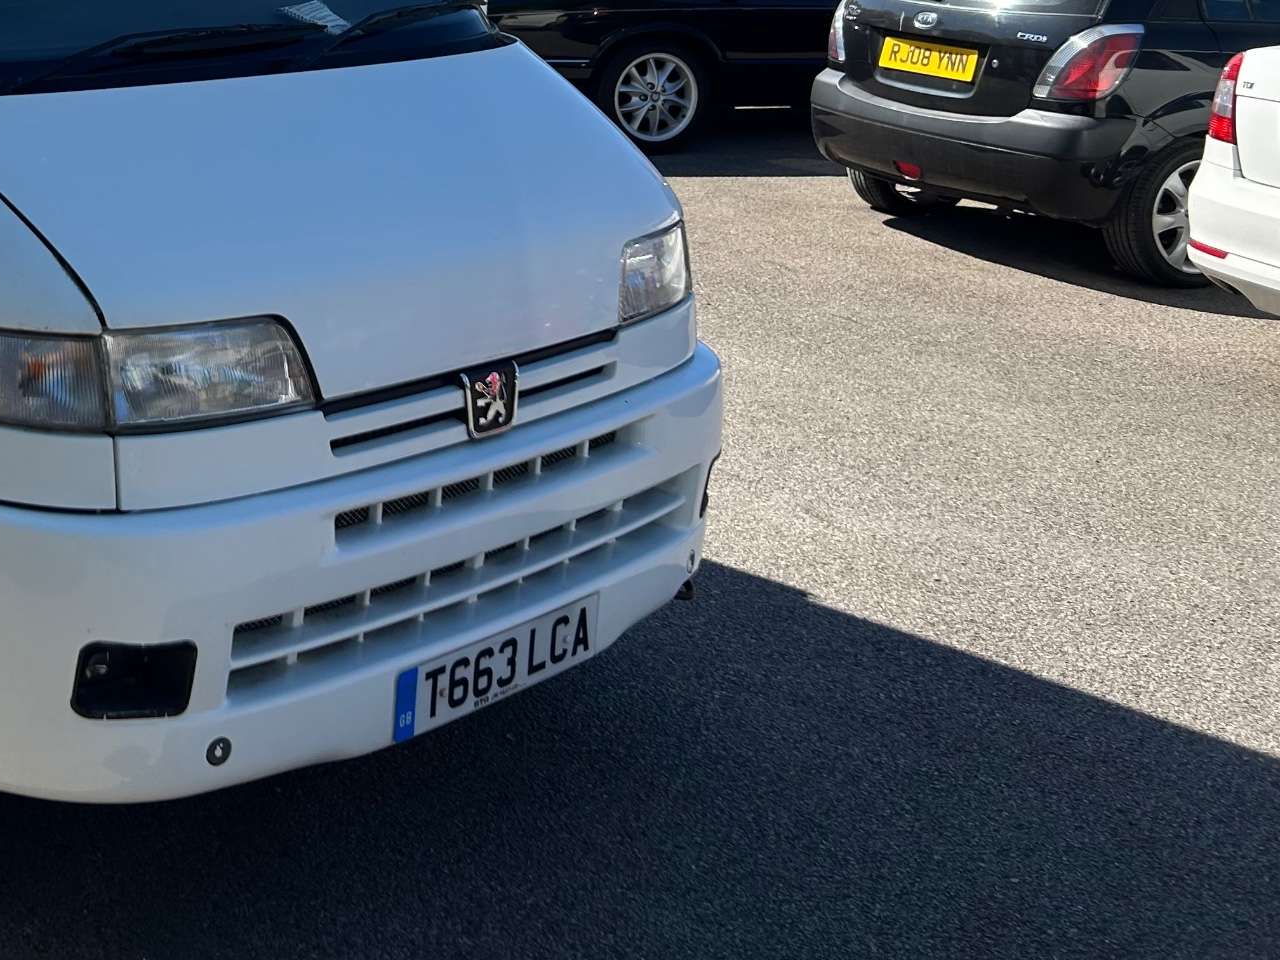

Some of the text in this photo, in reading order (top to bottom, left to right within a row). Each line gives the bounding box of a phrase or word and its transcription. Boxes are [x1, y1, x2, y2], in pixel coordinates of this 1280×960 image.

[888, 43, 970, 74] RJ08 YNN
[425, 606, 590, 718] T663 LCA
[400, 710, 413, 728] GB
